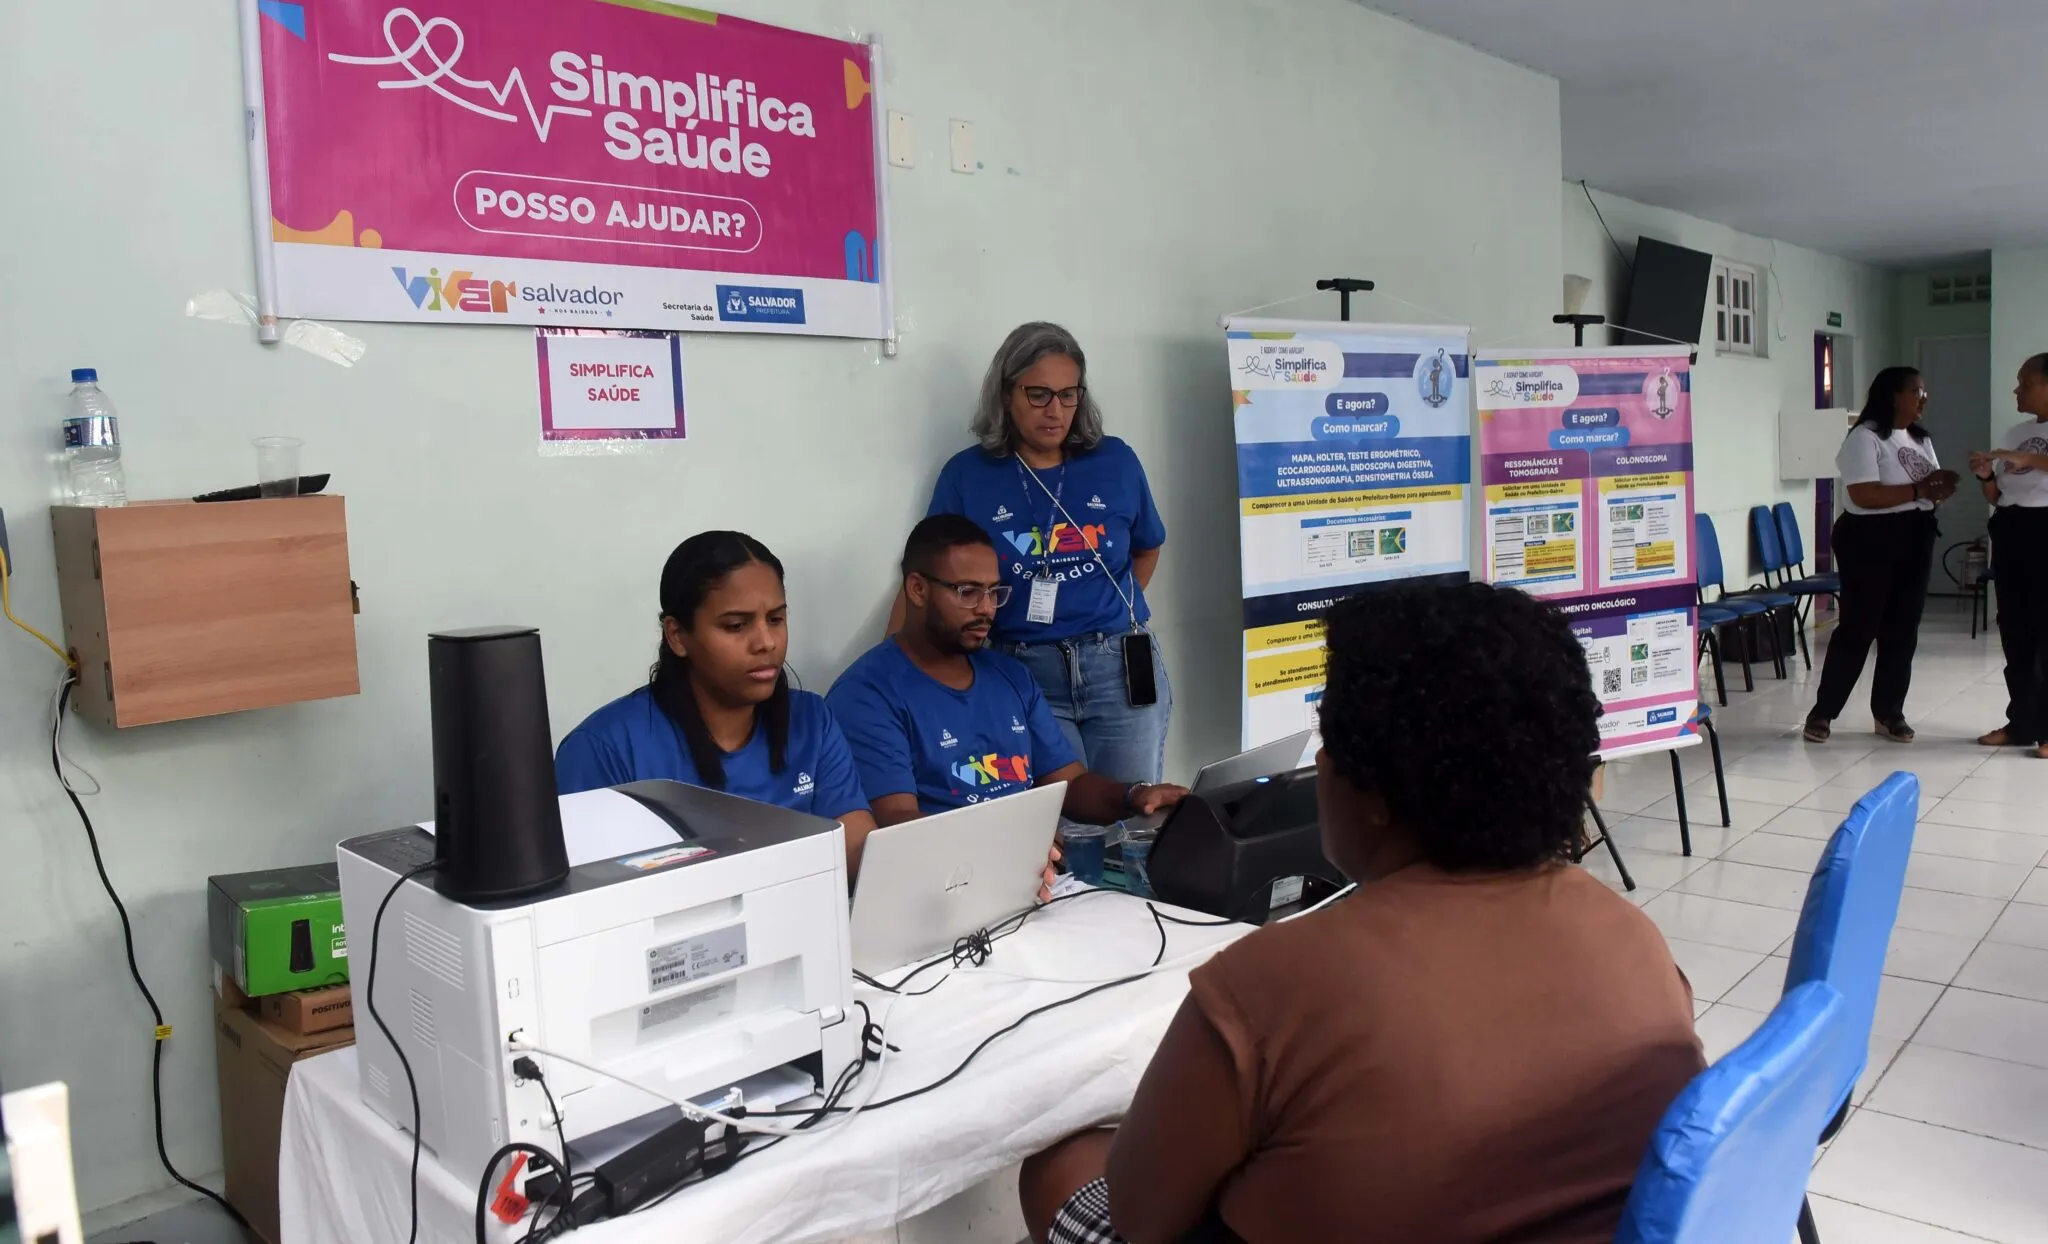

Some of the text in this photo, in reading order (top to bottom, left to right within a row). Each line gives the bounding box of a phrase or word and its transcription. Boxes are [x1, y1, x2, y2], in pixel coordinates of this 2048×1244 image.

[550, 51, 816, 138] Simplifica
[603, 111, 771, 178] Saúde
[475, 186, 746, 238] POSSO AJUDAR?
[522, 282, 624, 306] salvador
[663, 302, 700, 311] Secretaria
[748, 296, 796, 308] SALVADOR
[690, 313, 714, 321] Saúde
[570, 363, 654, 378] SIMPLIFICA
[1275, 358, 1327, 372] Simplifica
[588, 384, 640, 401] SAÚDE
[1515, 381, 1563, 393] Simplifica
[1337, 398, 1376, 411] E agora?
[1572, 413, 1608, 425] E agora?
[1323, 421, 1388, 433] Como marcar?
[1559, 432, 1619, 445] Como marcar?
[1291, 448, 1421, 463] MAPA, HOLTER, TESTE ERGOMÉTRICO,
[1616, 455, 1667, 465] COLONOSCOPIA
[1278, 459, 1433, 475] ECOCARDIOGRAMA, ENDOSCOPIA DIGESTIVA,
[1504, 458, 1563, 469] RESSONÂNCIAS E
[1277, 469, 1434, 488] ULTRASSONOGRAFIA, DENSITOMETRIA ÓSSEA
[1509, 467, 1558, 477] TOMOGRAFIAS
[1306, 497, 1328, 505] Unidade
[1297, 599, 1334, 611] CONSULTA
[1591, 597, 1636, 610] ONCOLÓGICO
[312, 1001, 351, 1015] POSITIVO
